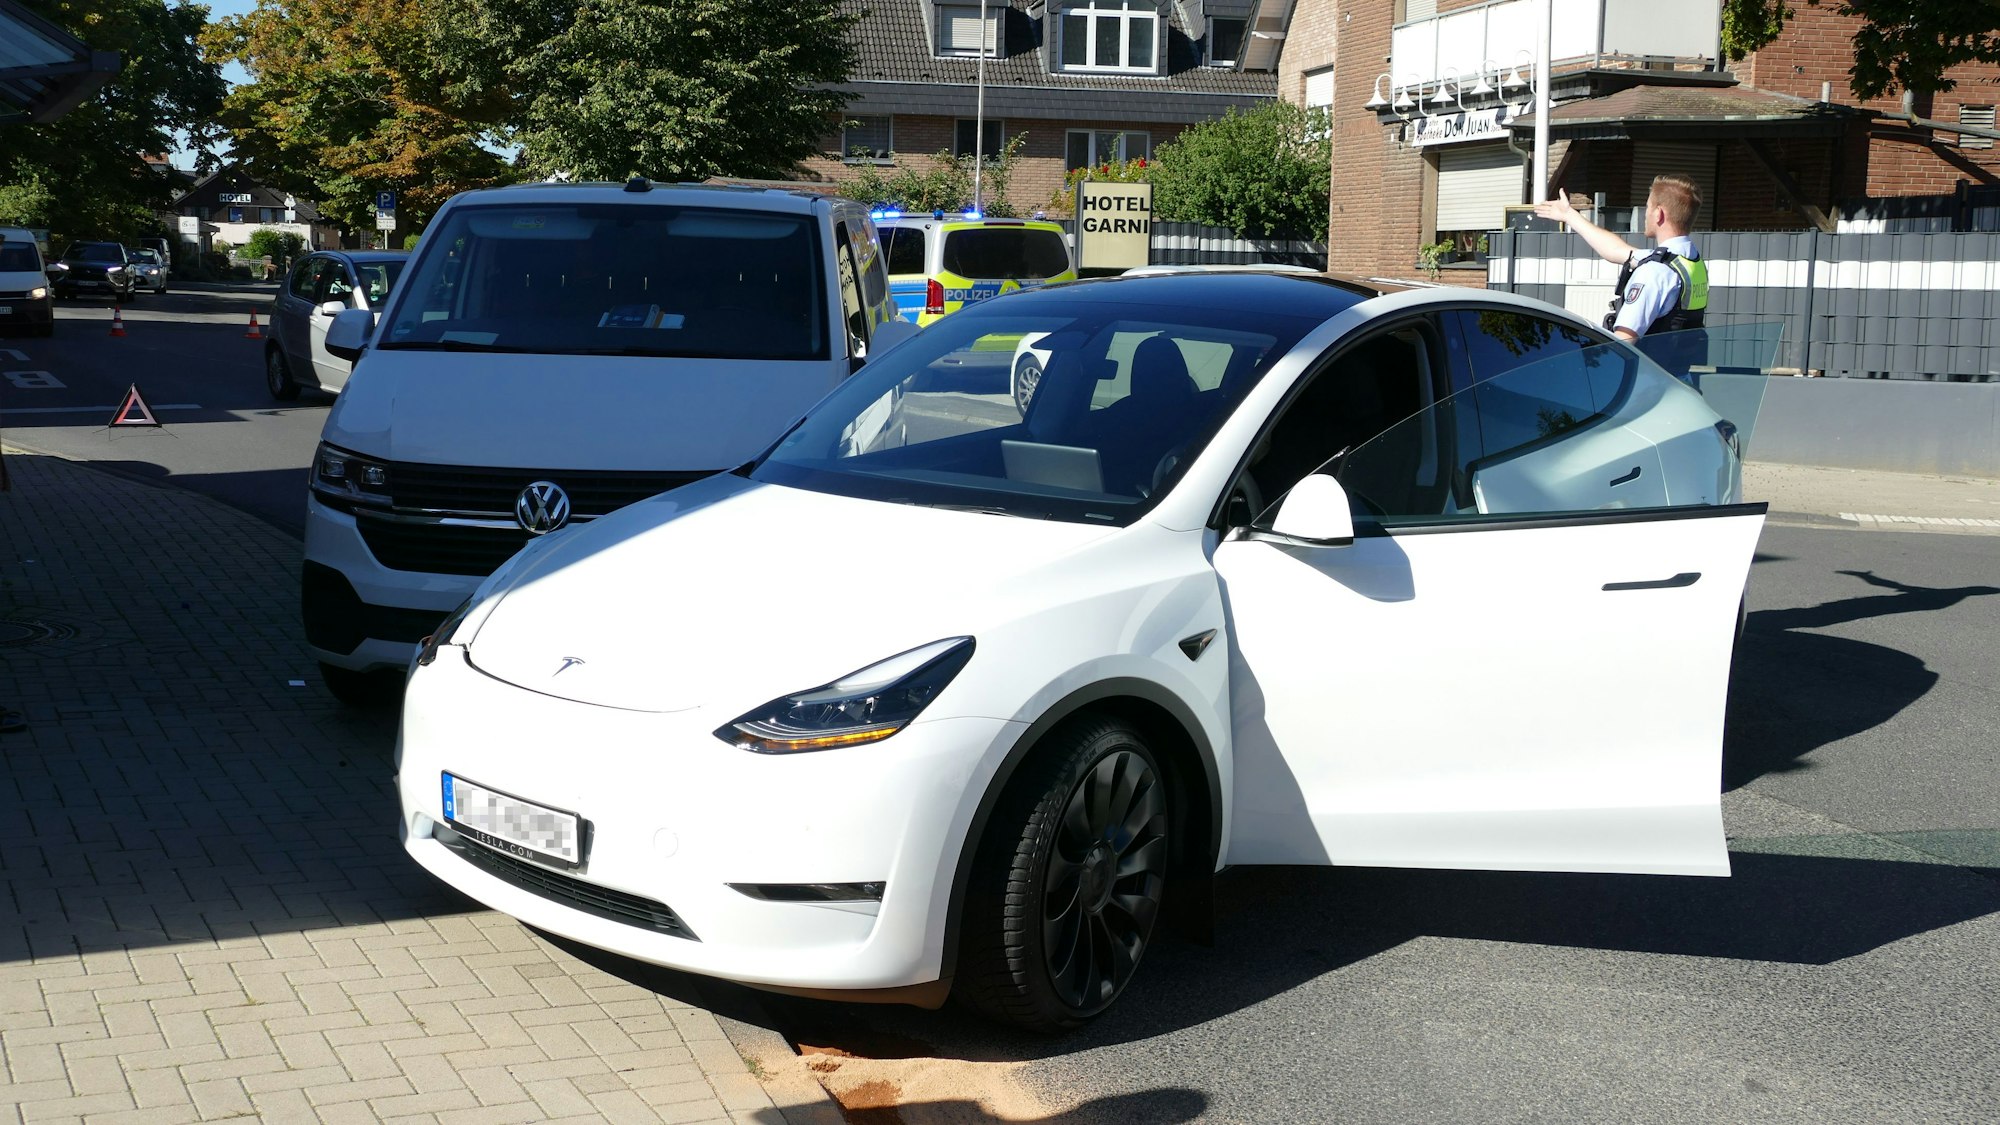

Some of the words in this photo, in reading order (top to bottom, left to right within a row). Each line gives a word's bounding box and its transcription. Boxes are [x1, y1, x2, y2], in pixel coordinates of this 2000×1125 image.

[1466, 116, 1490, 137] JUAN
[220, 194, 251, 202] HOTEL
[381, 192, 391, 207] P
[1083, 196, 1150, 211] HOTEL
[1083, 218, 1148, 234] GARNI
[945, 289, 995, 301] POLIZEI
[446, 801, 452, 811] D
[475, 831, 534, 859] TESLA.COM
